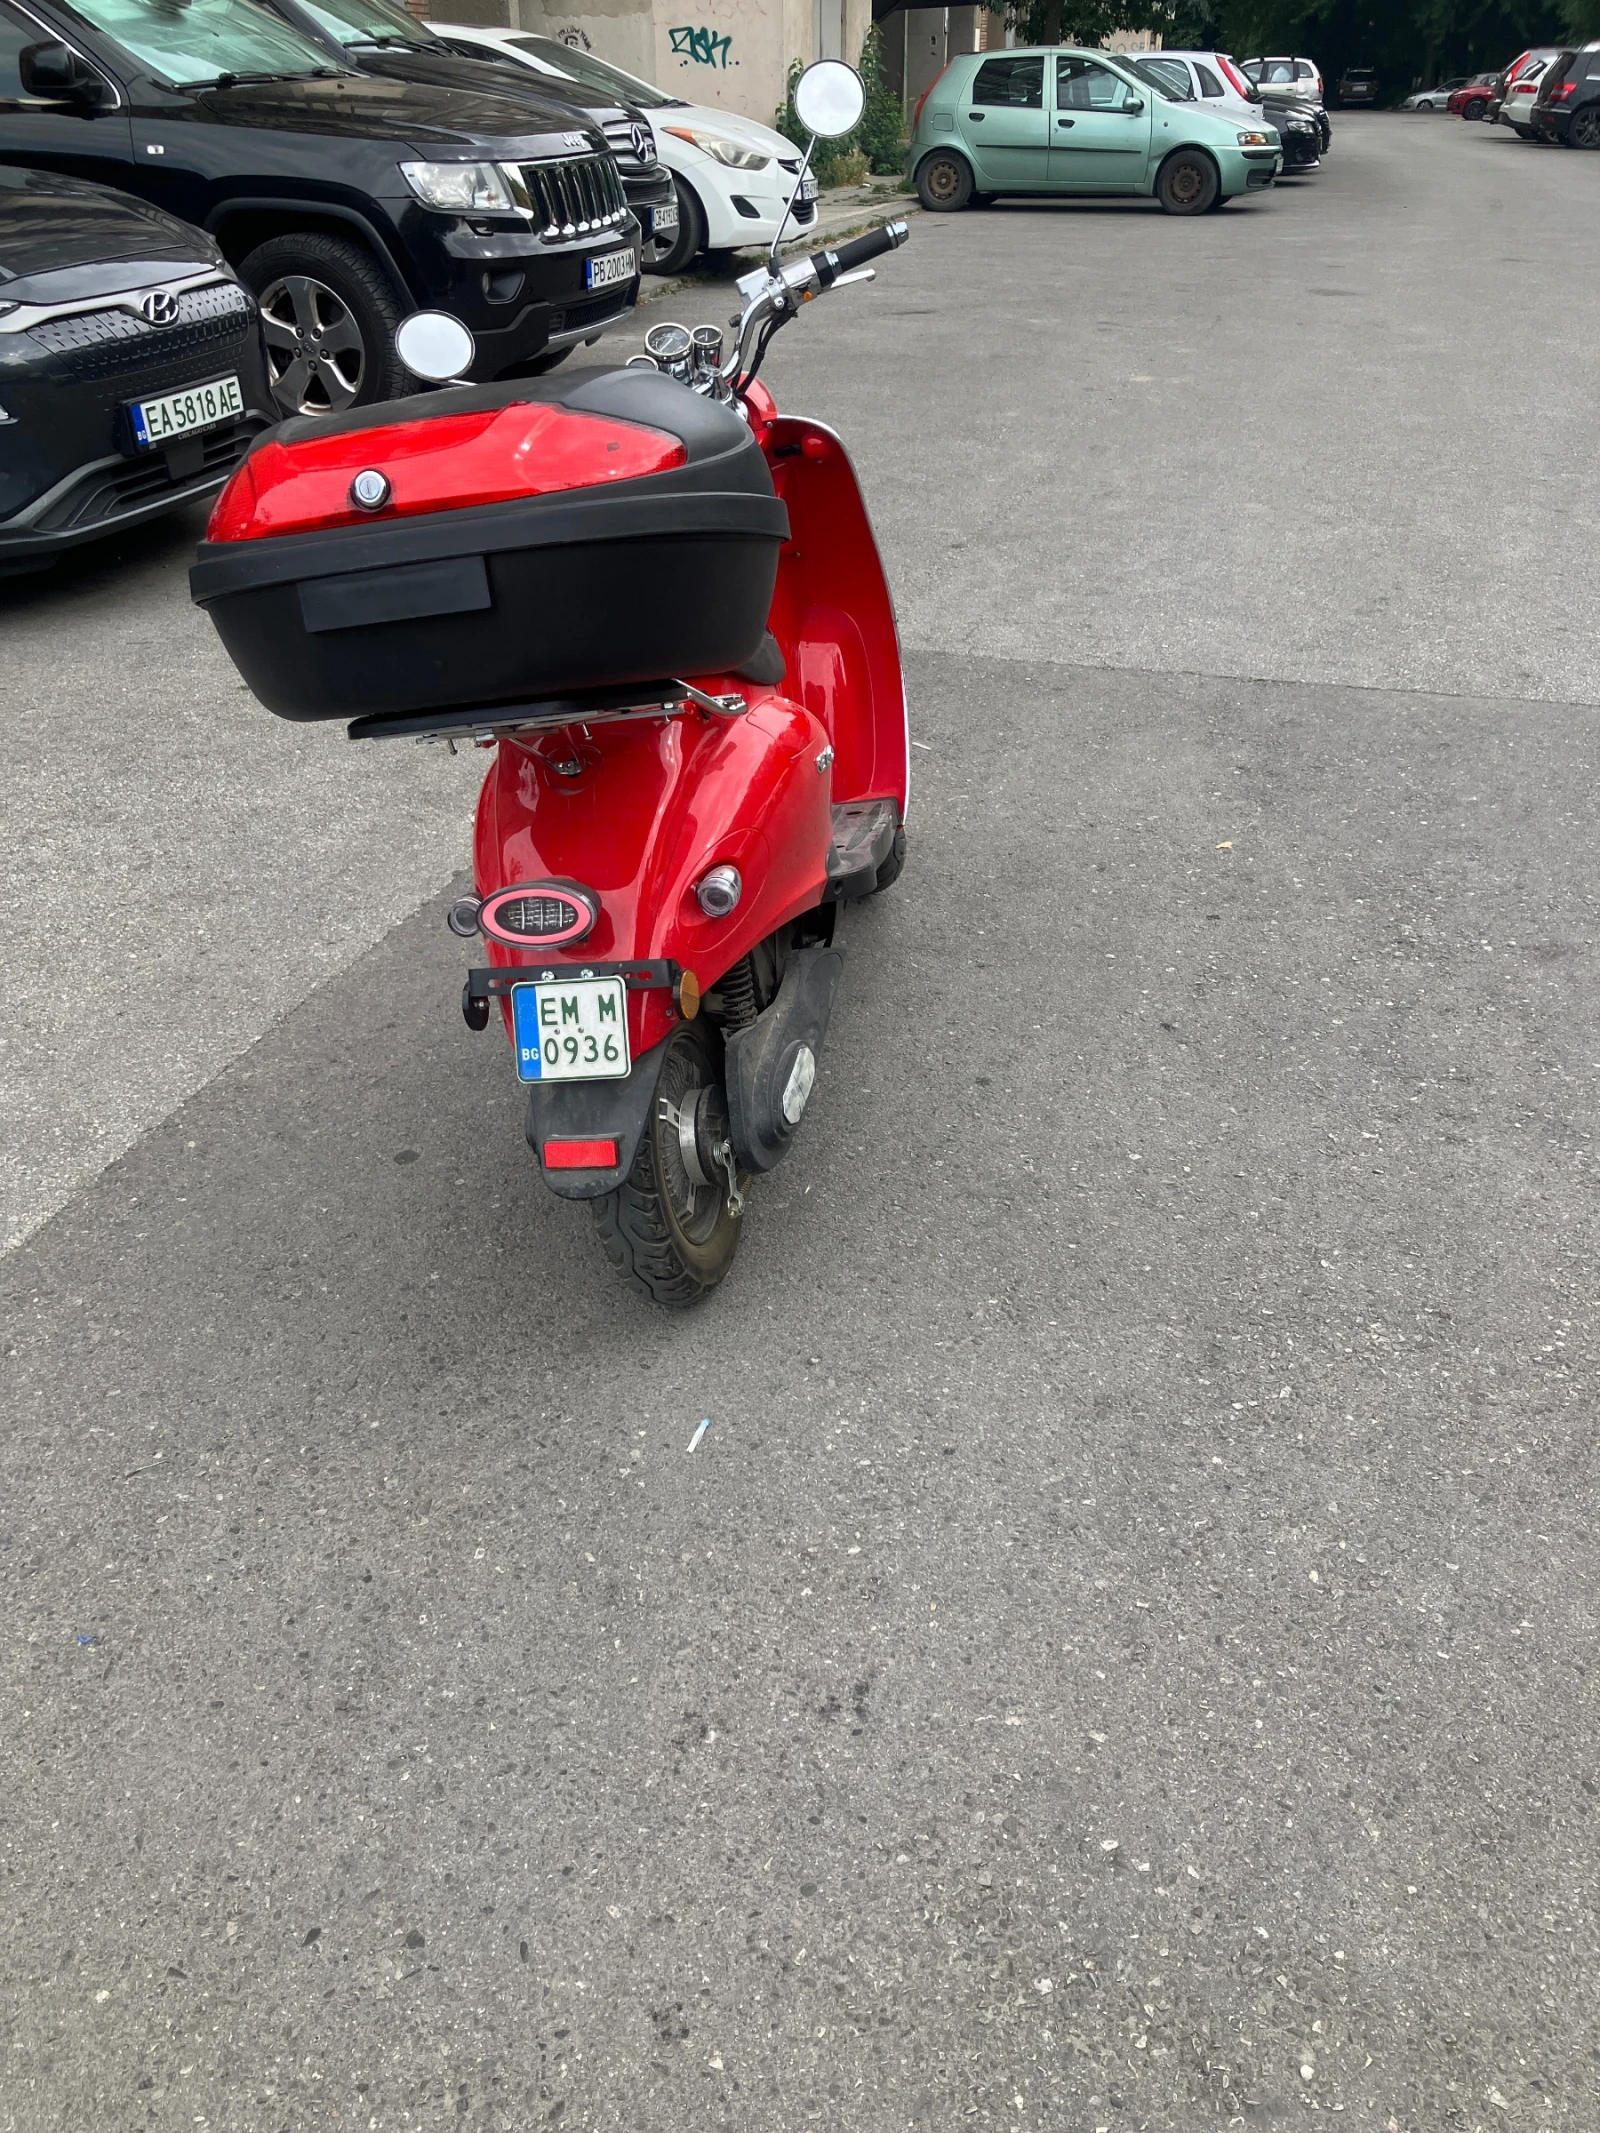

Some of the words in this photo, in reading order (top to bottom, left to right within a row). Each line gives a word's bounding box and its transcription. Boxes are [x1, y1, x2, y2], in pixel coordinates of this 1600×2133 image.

[562, 132, 586, 149] Jeep
[593, 260, 606, 284] PB
[606, 255, 625, 281] 2003
[145, 402, 174, 437] EA
[172, 388, 217, 428] 5818
[218, 381, 241, 415] AE
[137, 429, 148, 441] BG
[177, 427, 203, 440] CHICAGO
[203, 423, 217, 432] CARS
[540, 995, 580, 1026] EM
[597, 993, 617, 1022] M
[521, 1048, 539, 1061] BG
[543, 1033, 620, 1065] 0936
